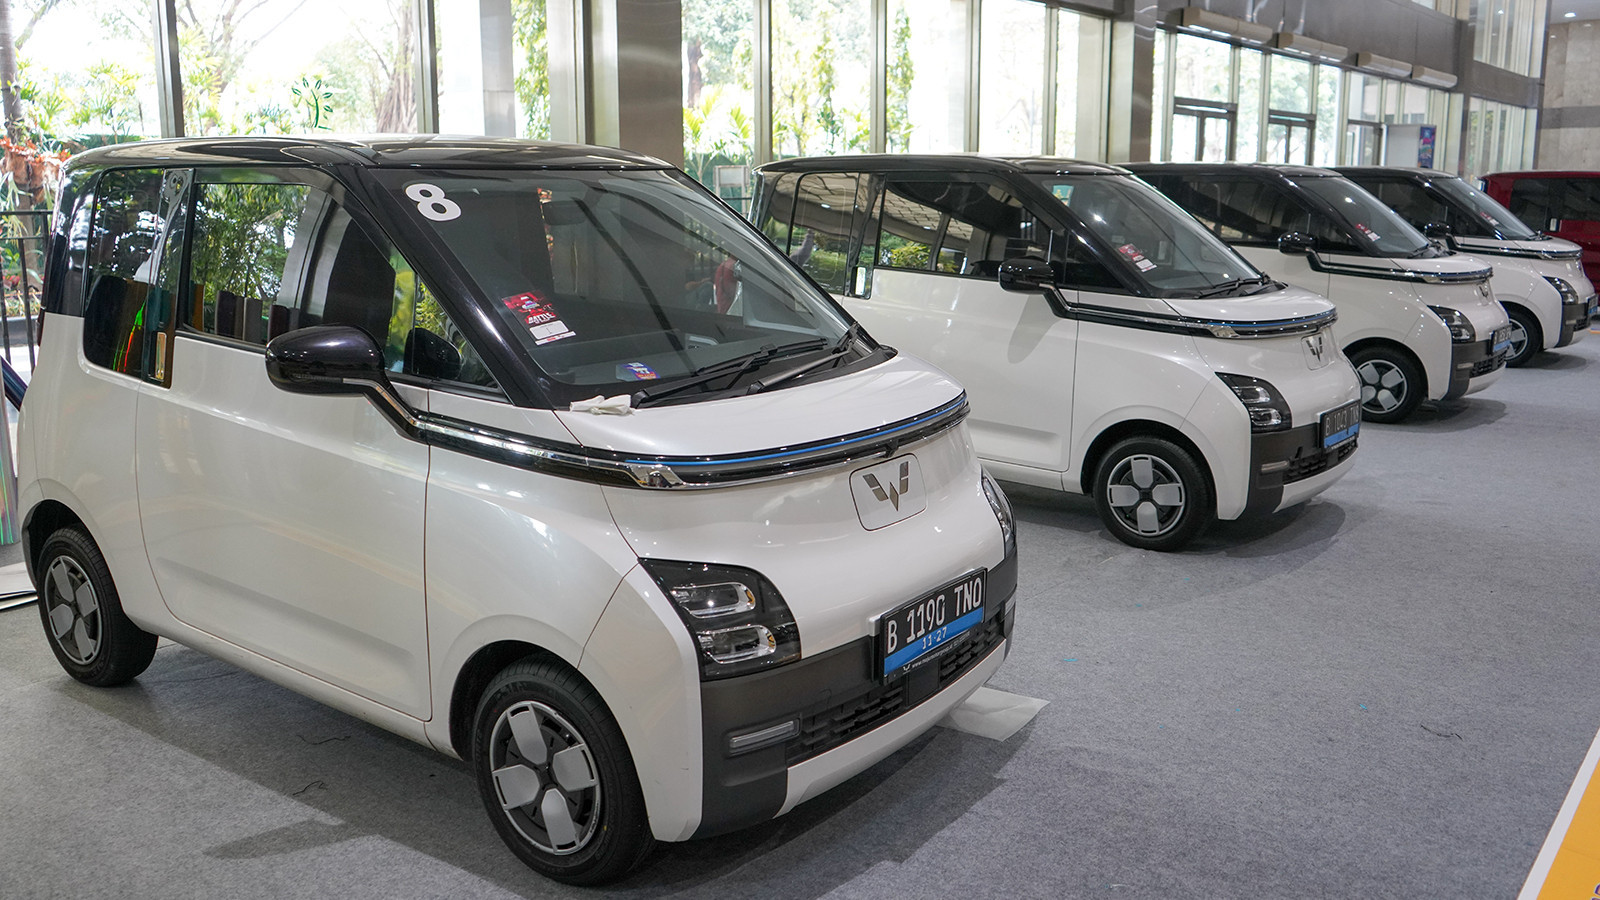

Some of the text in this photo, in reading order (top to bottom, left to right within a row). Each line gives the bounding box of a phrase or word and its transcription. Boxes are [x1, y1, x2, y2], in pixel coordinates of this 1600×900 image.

[405, 183, 461, 221] 8
[887, 620, 898, 654] B
[906, 594, 946, 644] 1190
[954, 577, 982, 616] TNO
